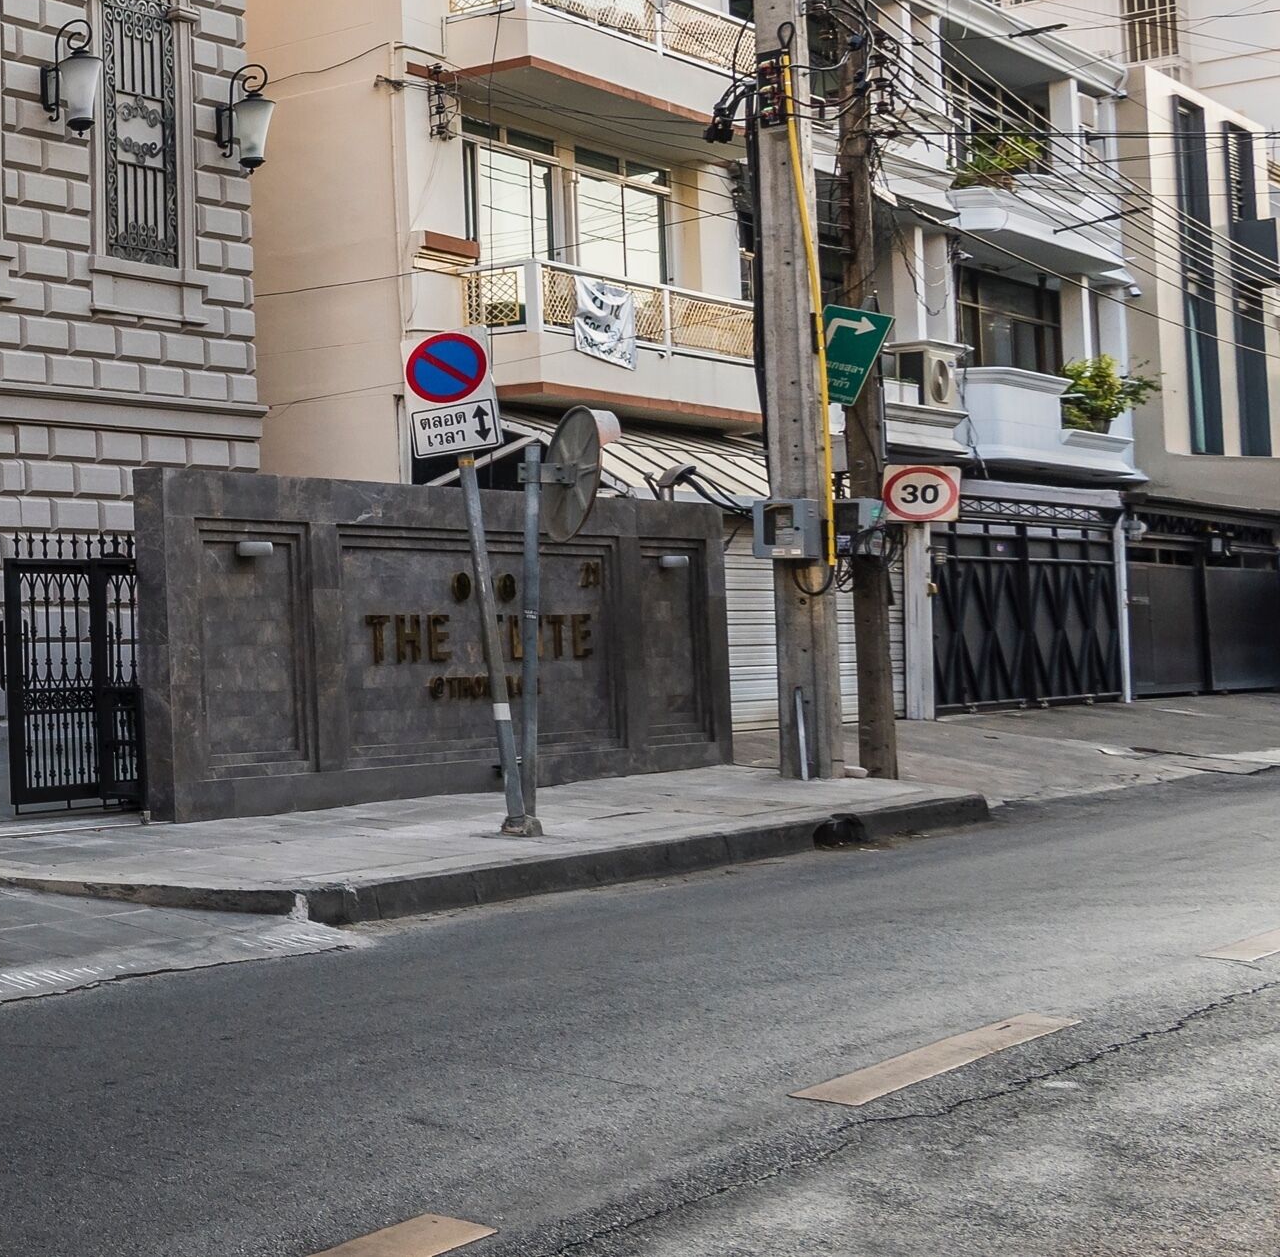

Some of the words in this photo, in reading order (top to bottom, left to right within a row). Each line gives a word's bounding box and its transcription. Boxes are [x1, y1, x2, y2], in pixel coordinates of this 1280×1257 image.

[419, 411, 467, 431] ตลอด
[427, 429, 466, 447] เวลา
[900, 484, 940, 504] 30
[364, 614, 452, 664] THE
